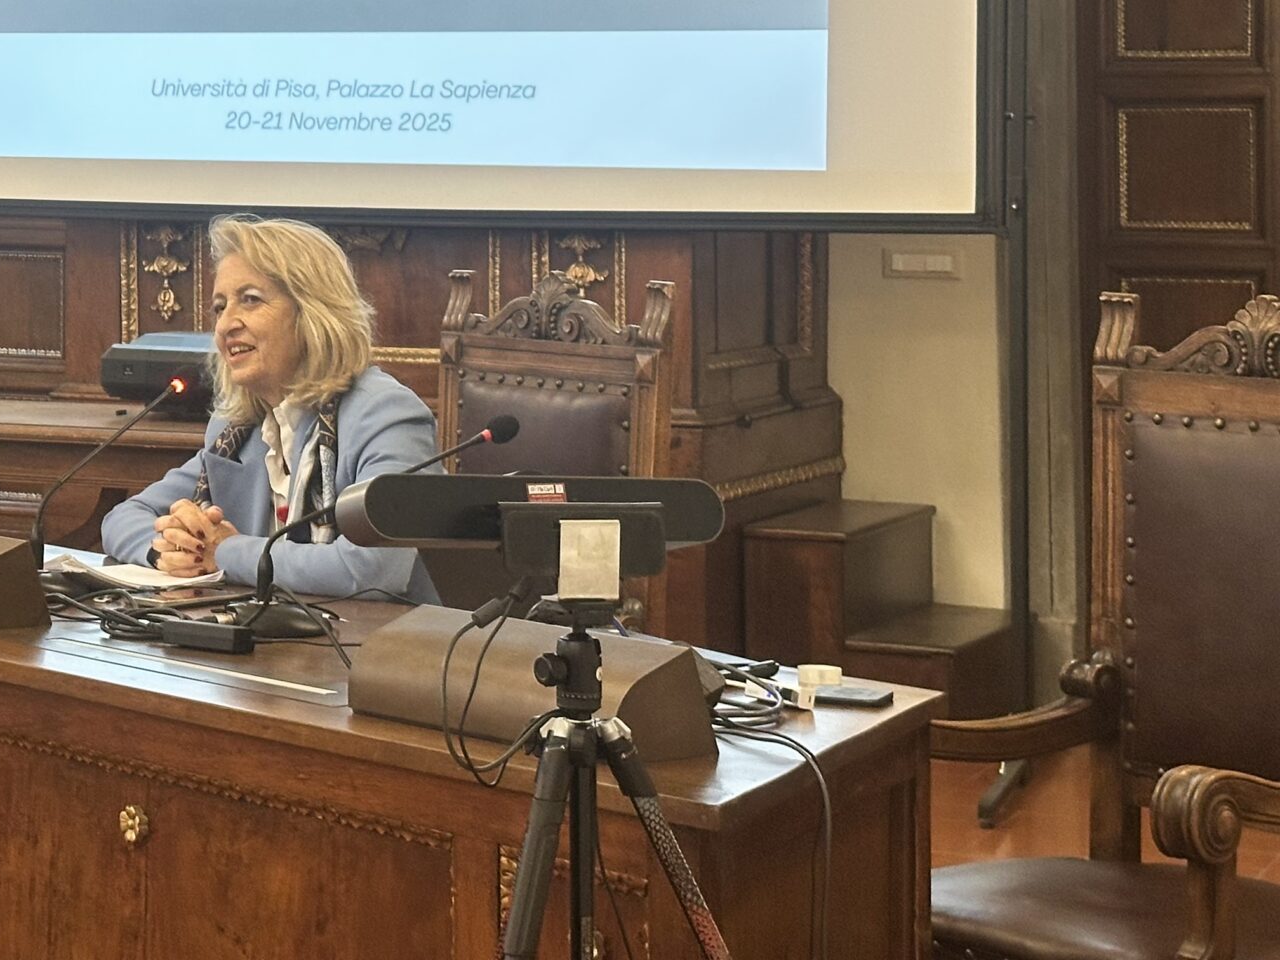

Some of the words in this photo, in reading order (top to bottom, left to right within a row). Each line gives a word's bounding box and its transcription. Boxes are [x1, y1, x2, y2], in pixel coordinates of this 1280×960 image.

[151, 78, 247, 98] Università
[252, 78, 271, 98] di
[275, 79, 320, 101] Pisa,
[326, 79, 404, 98] Palazzo
[409, 80, 435, 99] La
[440, 79, 536, 103] Sapienza
[225, 110, 283, 130] 20-21
[288, 112, 393, 131] Novembre
[398, 112, 452, 132] 2025
